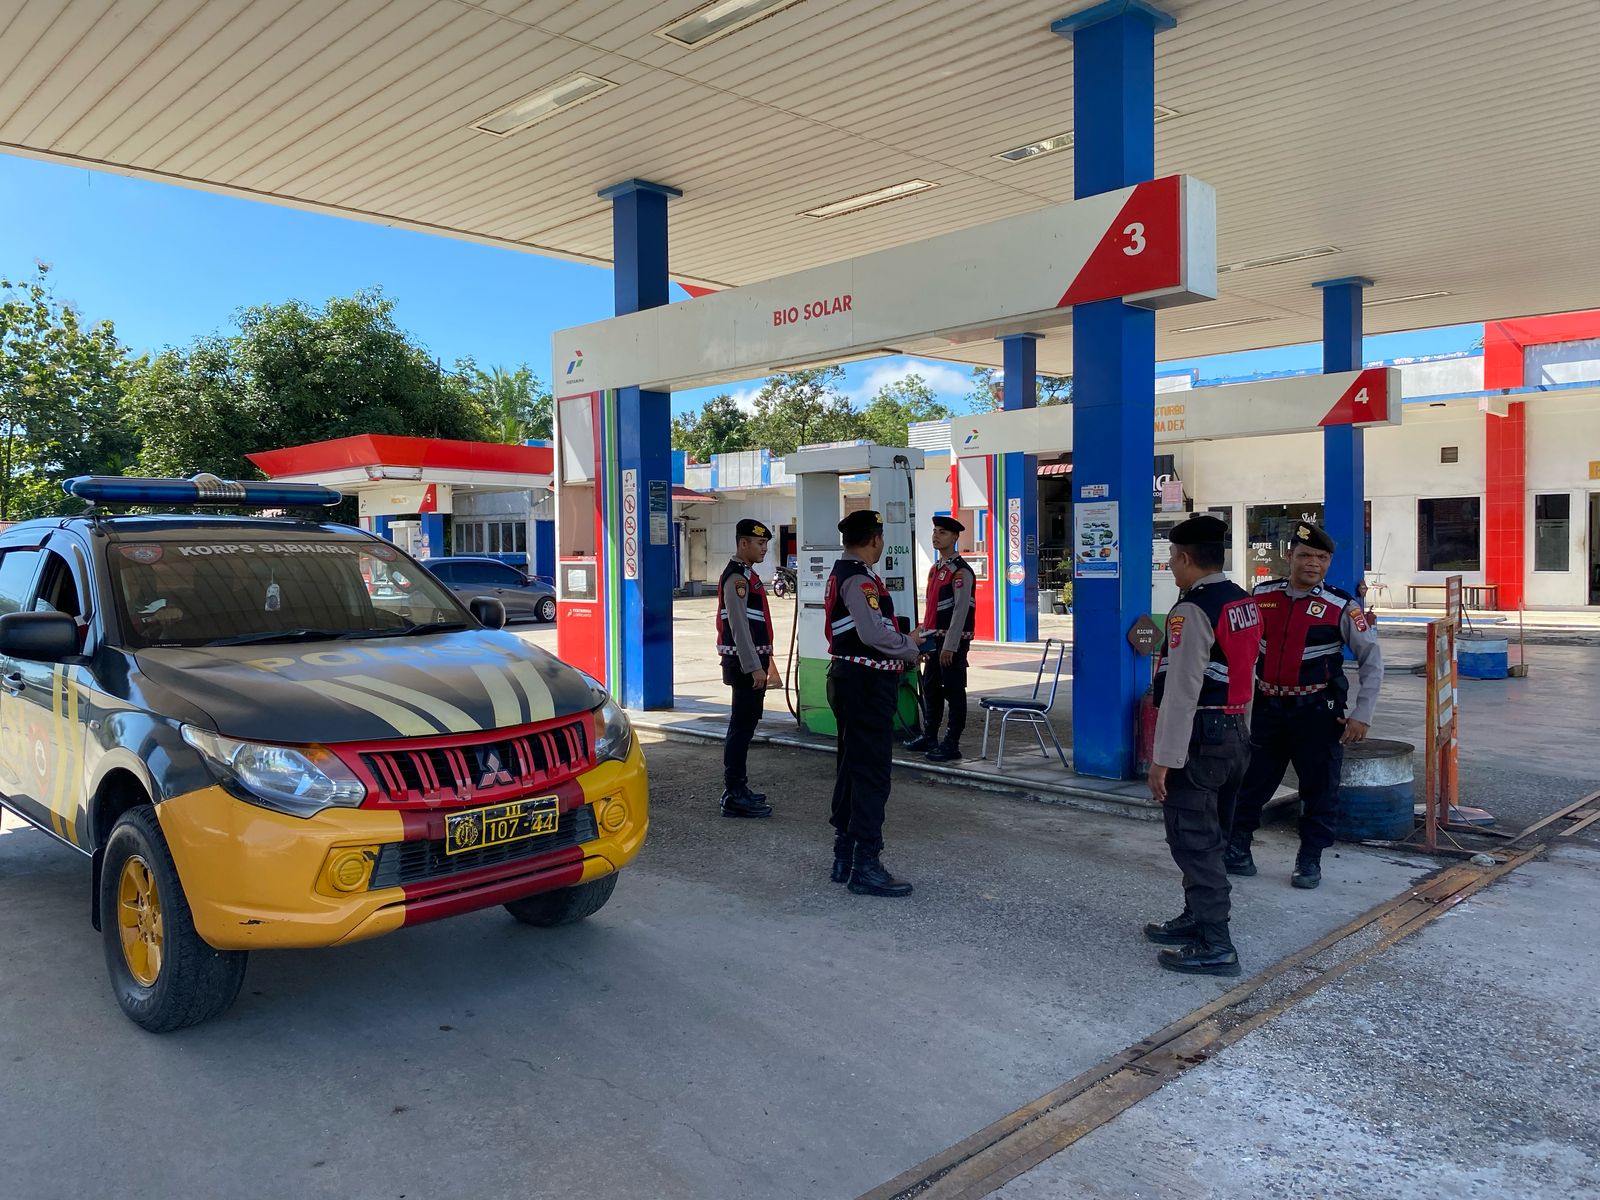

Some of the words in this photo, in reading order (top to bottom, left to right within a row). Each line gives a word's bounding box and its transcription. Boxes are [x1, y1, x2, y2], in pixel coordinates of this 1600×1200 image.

[1122, 222, 1146, 256] 3
[773, 307, 799, 326] BIO
[803, 294, 852, 320] SOLAR
[1354, 387, 1369, 404] 4
[1168, 419, 1185, 431] DEX
[178, 544, 255, 556] KORPS
[258, 544, 356, 554] SABHARA
[505, 804, 521, 816] III
